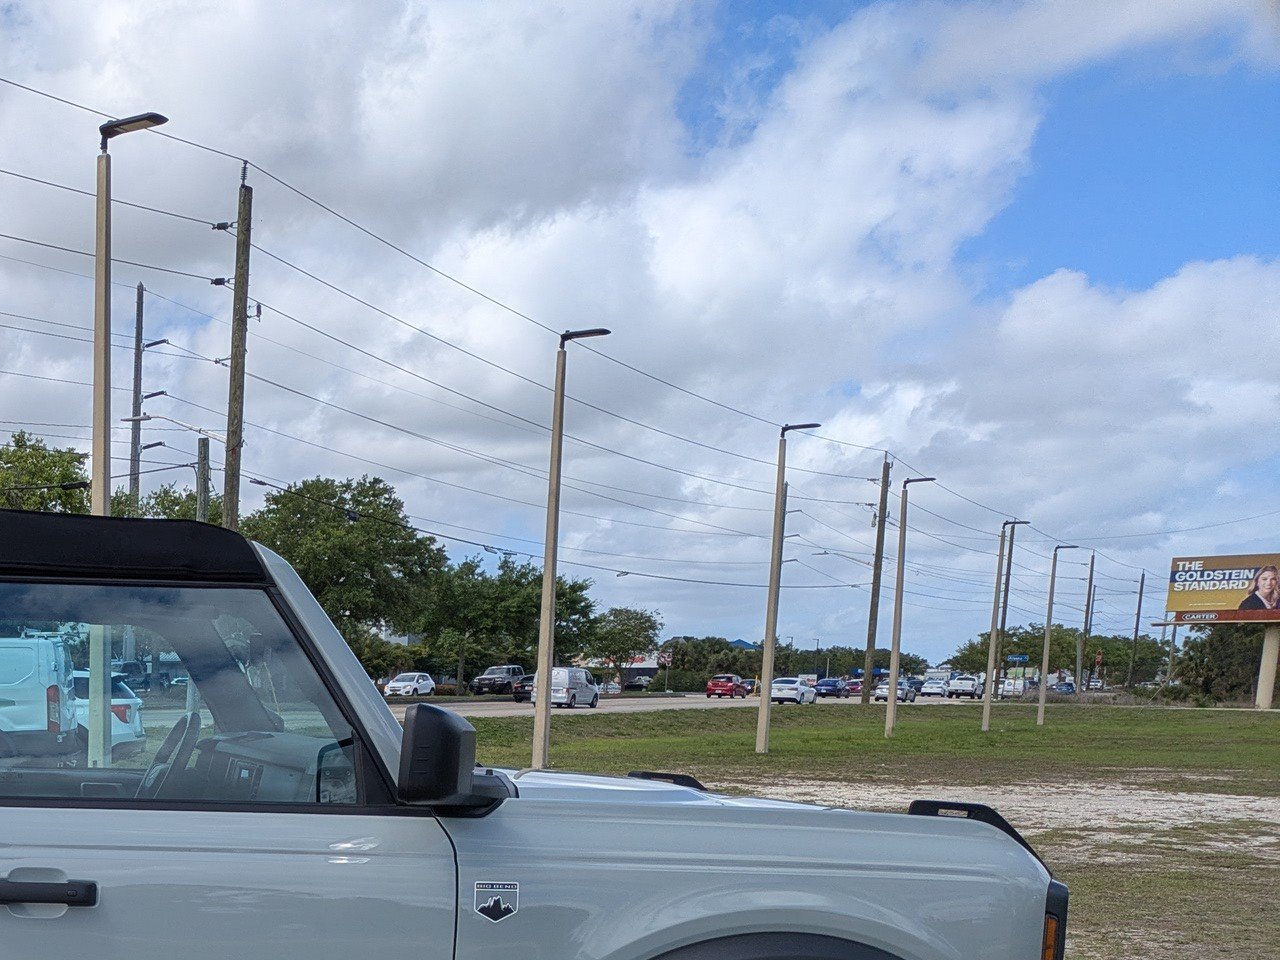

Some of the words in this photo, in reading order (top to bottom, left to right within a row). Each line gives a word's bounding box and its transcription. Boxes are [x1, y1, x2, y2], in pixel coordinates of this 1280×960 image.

[1177, 561, 1204, 571] THE
[1175, 569, 1254, 581] GOLDSTEIN
[1173, 580, 1248, 591] STANDARD
